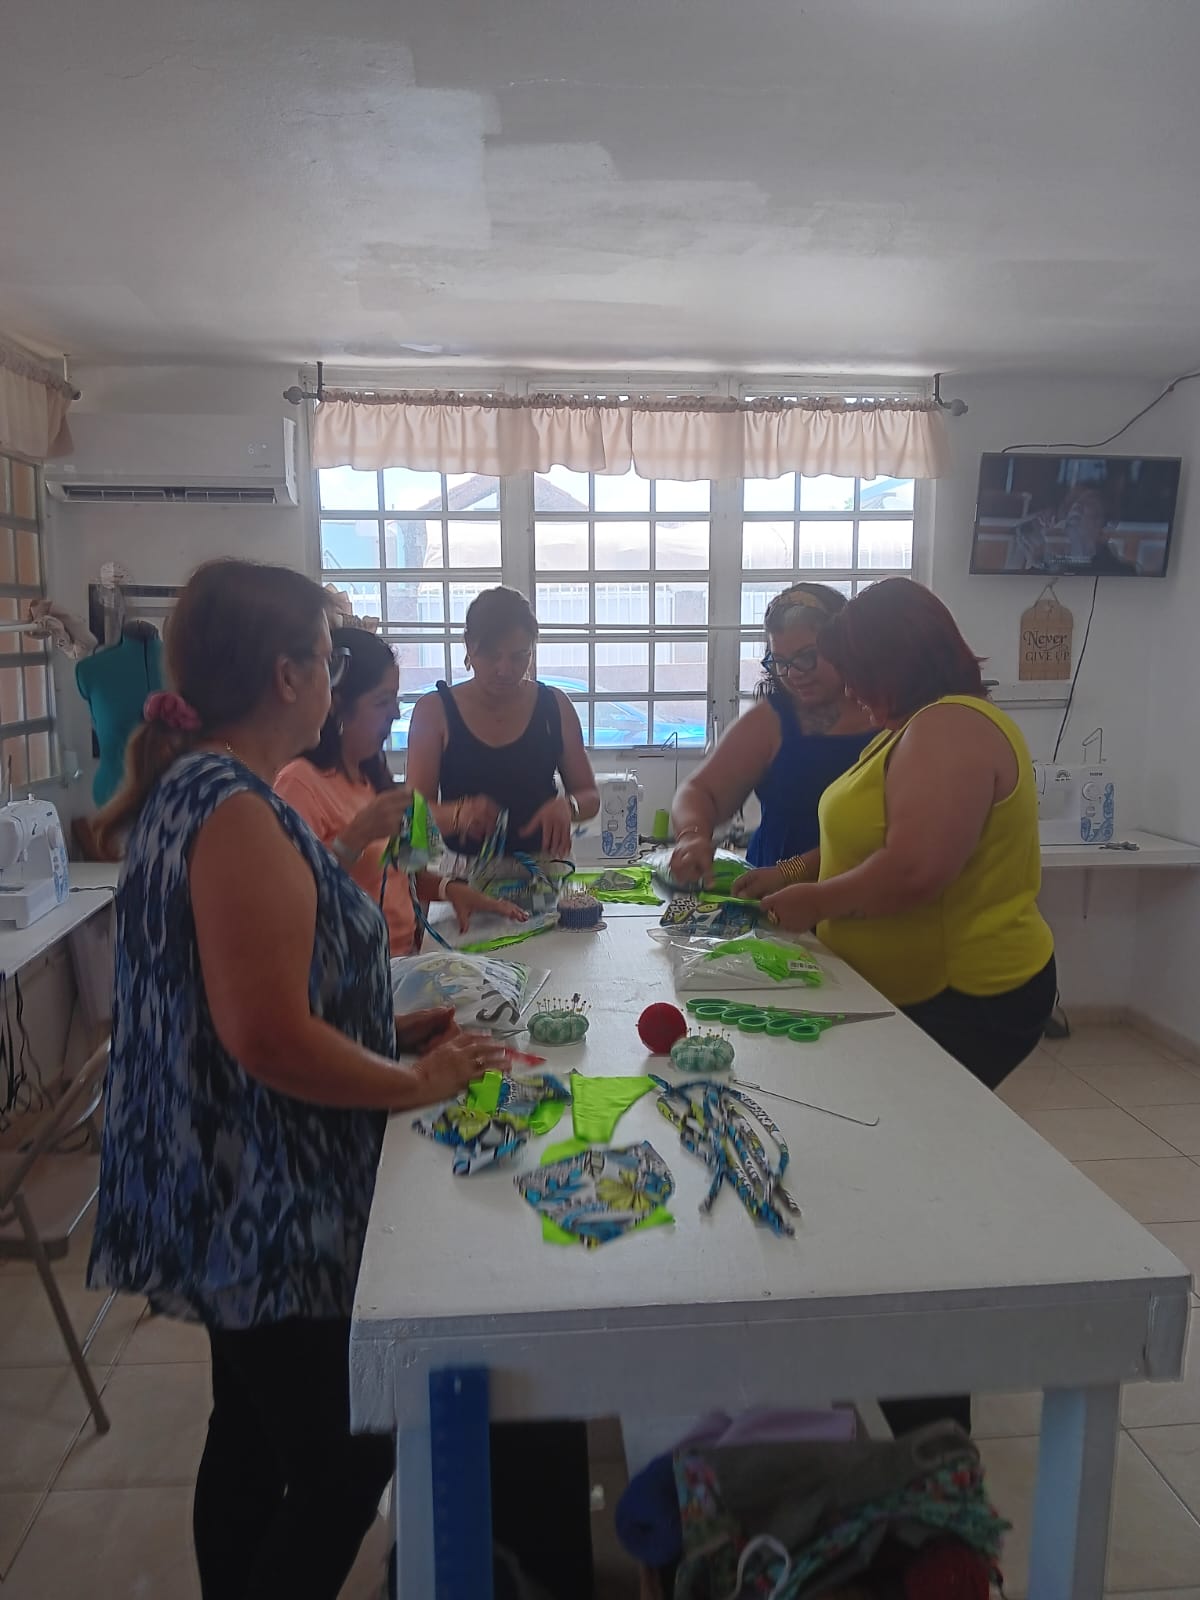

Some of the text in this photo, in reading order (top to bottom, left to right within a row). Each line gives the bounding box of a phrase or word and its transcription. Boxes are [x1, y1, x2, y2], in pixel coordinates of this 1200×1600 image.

[1023, 631, 1068, 651] Never
[1025, 652, 1070, 663] GIVE UP
